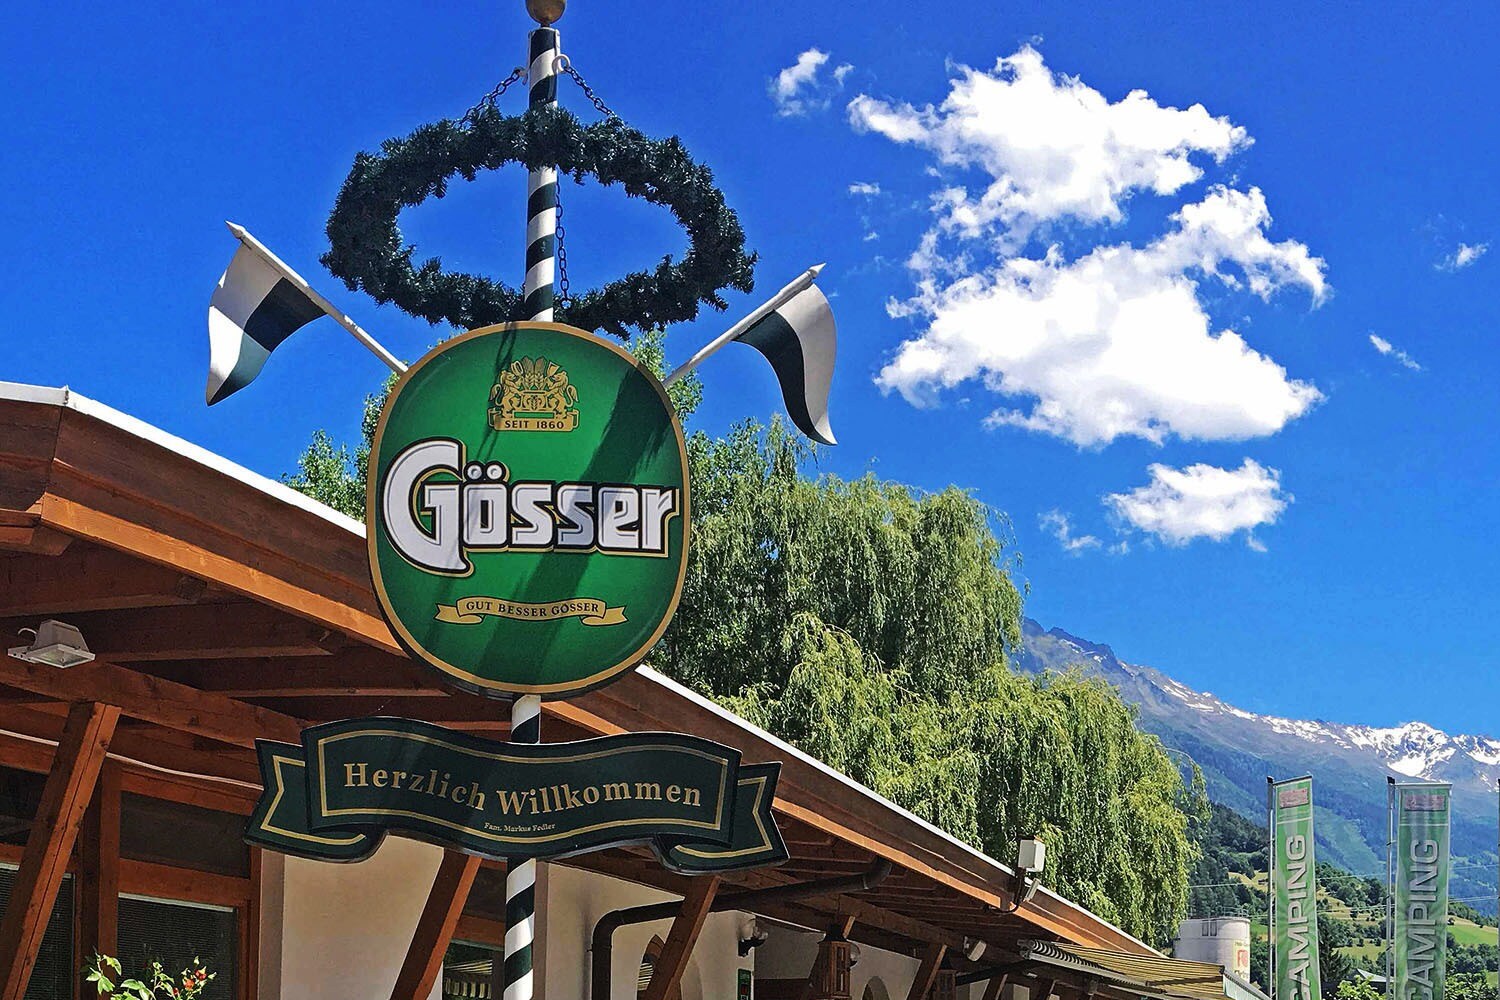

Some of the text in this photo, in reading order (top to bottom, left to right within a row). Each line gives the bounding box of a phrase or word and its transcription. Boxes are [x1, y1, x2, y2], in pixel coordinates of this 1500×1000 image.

[505, 420, 564, 429] SEIT 1860
[382, 437, 677, 575] Gösser
[466, 601, 493, 611] GUT
[498, 603, 548, 617] BESSER
[343, 762, 702, 815] Herzlich Willkommen
